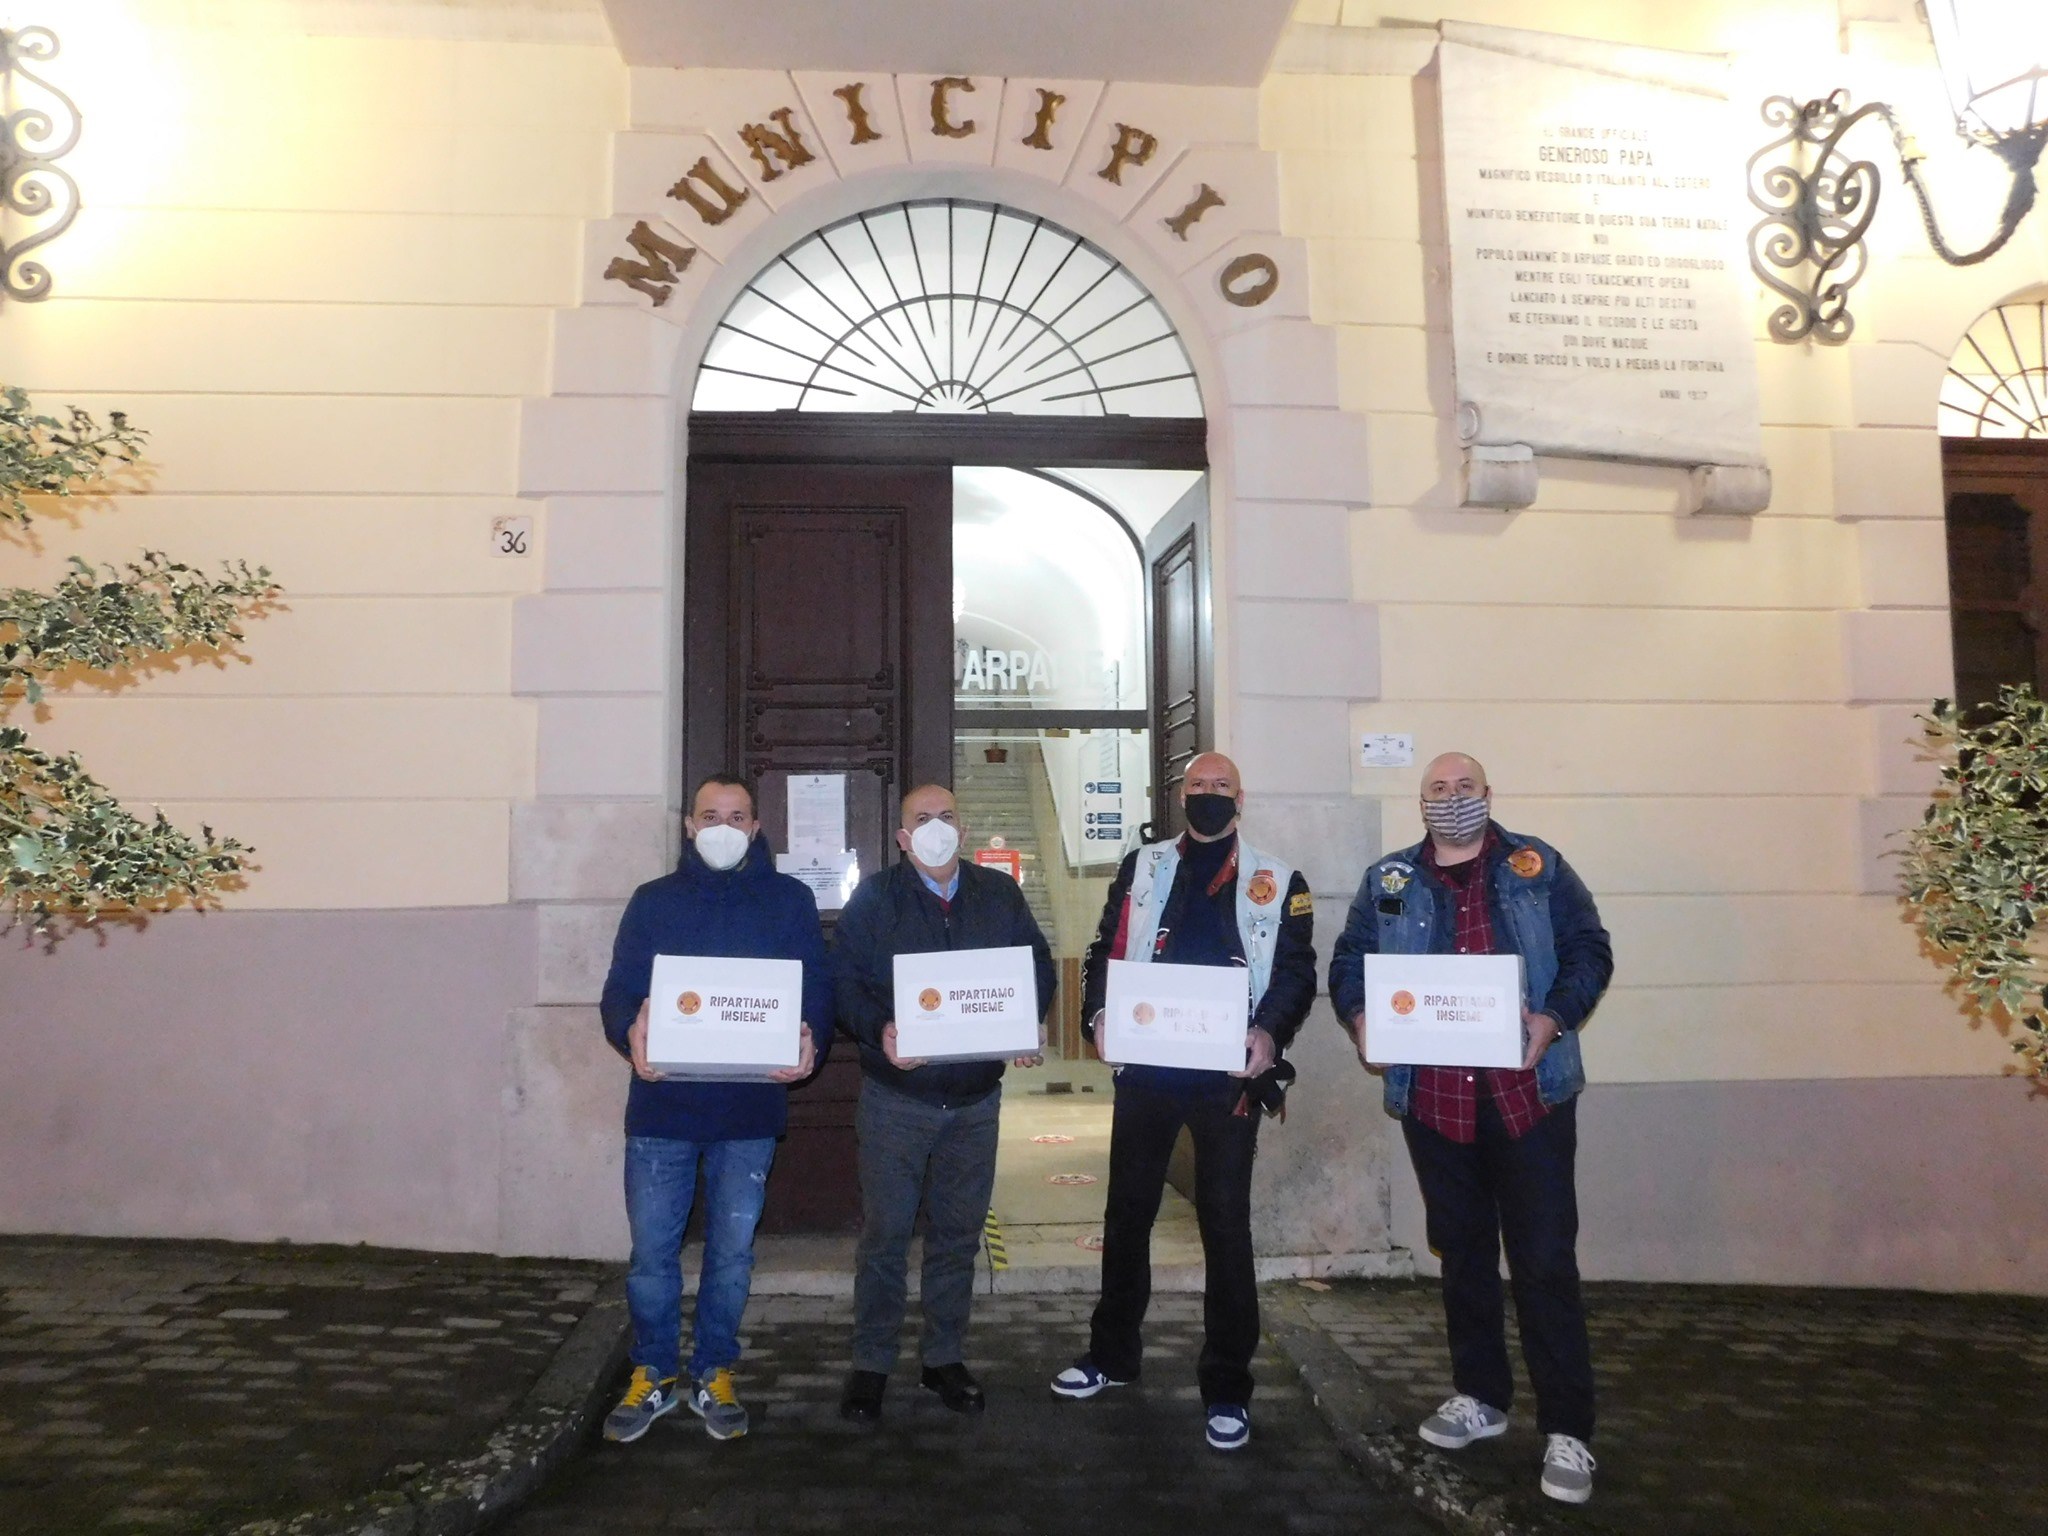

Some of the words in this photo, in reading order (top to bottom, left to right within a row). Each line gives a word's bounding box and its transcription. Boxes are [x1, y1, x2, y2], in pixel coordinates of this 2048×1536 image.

[1539, 145, 1608, 165] GENEROSO
[1620, 149, 1653, 167] PAPA
[1478, 168, 1531, 182] MAGNIFICO
[603, 77, 1279, 308] MUNICIPIO
[1598, 214, 1634, 228] QUESTA
[1476, 248, 1514, 261] POPOLO
[1516, 250, 1558, 263] UNANIME
[1616, 254, 1644, 267] GRATO
[1648, 256, 1661, 268] ED
[1515, 270, 1554, 284] MENTRE
[1559, 272, 1581, 285] EGLI
[1586, 274, 1655, 288] TENACEMENTE
[1658, 277, 1690, 290] OPERA
[1510, 292, 1556, 304] LANCIATO
[1561, 293, 1567, 304] A
[1572, 294, 1610, 307] SEMPRE
[1636, 296, 1654, 308] ALTI
[1508, 312, 1522, 324] NE
[1526, 313, 1580, 326] ETERNIAMO
[1642, 318, 1647, 330] E
[1652, 318, 1664, 331] LE
[1670, 319, 1698, 332] GESTA
[1582, 336, 1606, 349] DOVE
[1487, 351, 1492, 364] E
[1498, 352, 1529, 365] DONDE
[1586, 356, 1611, 369] VOLO
[1616, 358, 1622, 369] A
[1664, 360, 1676, 372] LA
[1680, 360, 1724, 373] FORTUNA
[501, 530, 527, 554] 36
[949, 987, 1015, 1001] RIPARTIAMO
[710, 996, 779, 1010] RIPARTIAMO
[960, 1001, 1005, 1014] INSIEME
[720, 1010, 766, 1022] INSIEME
